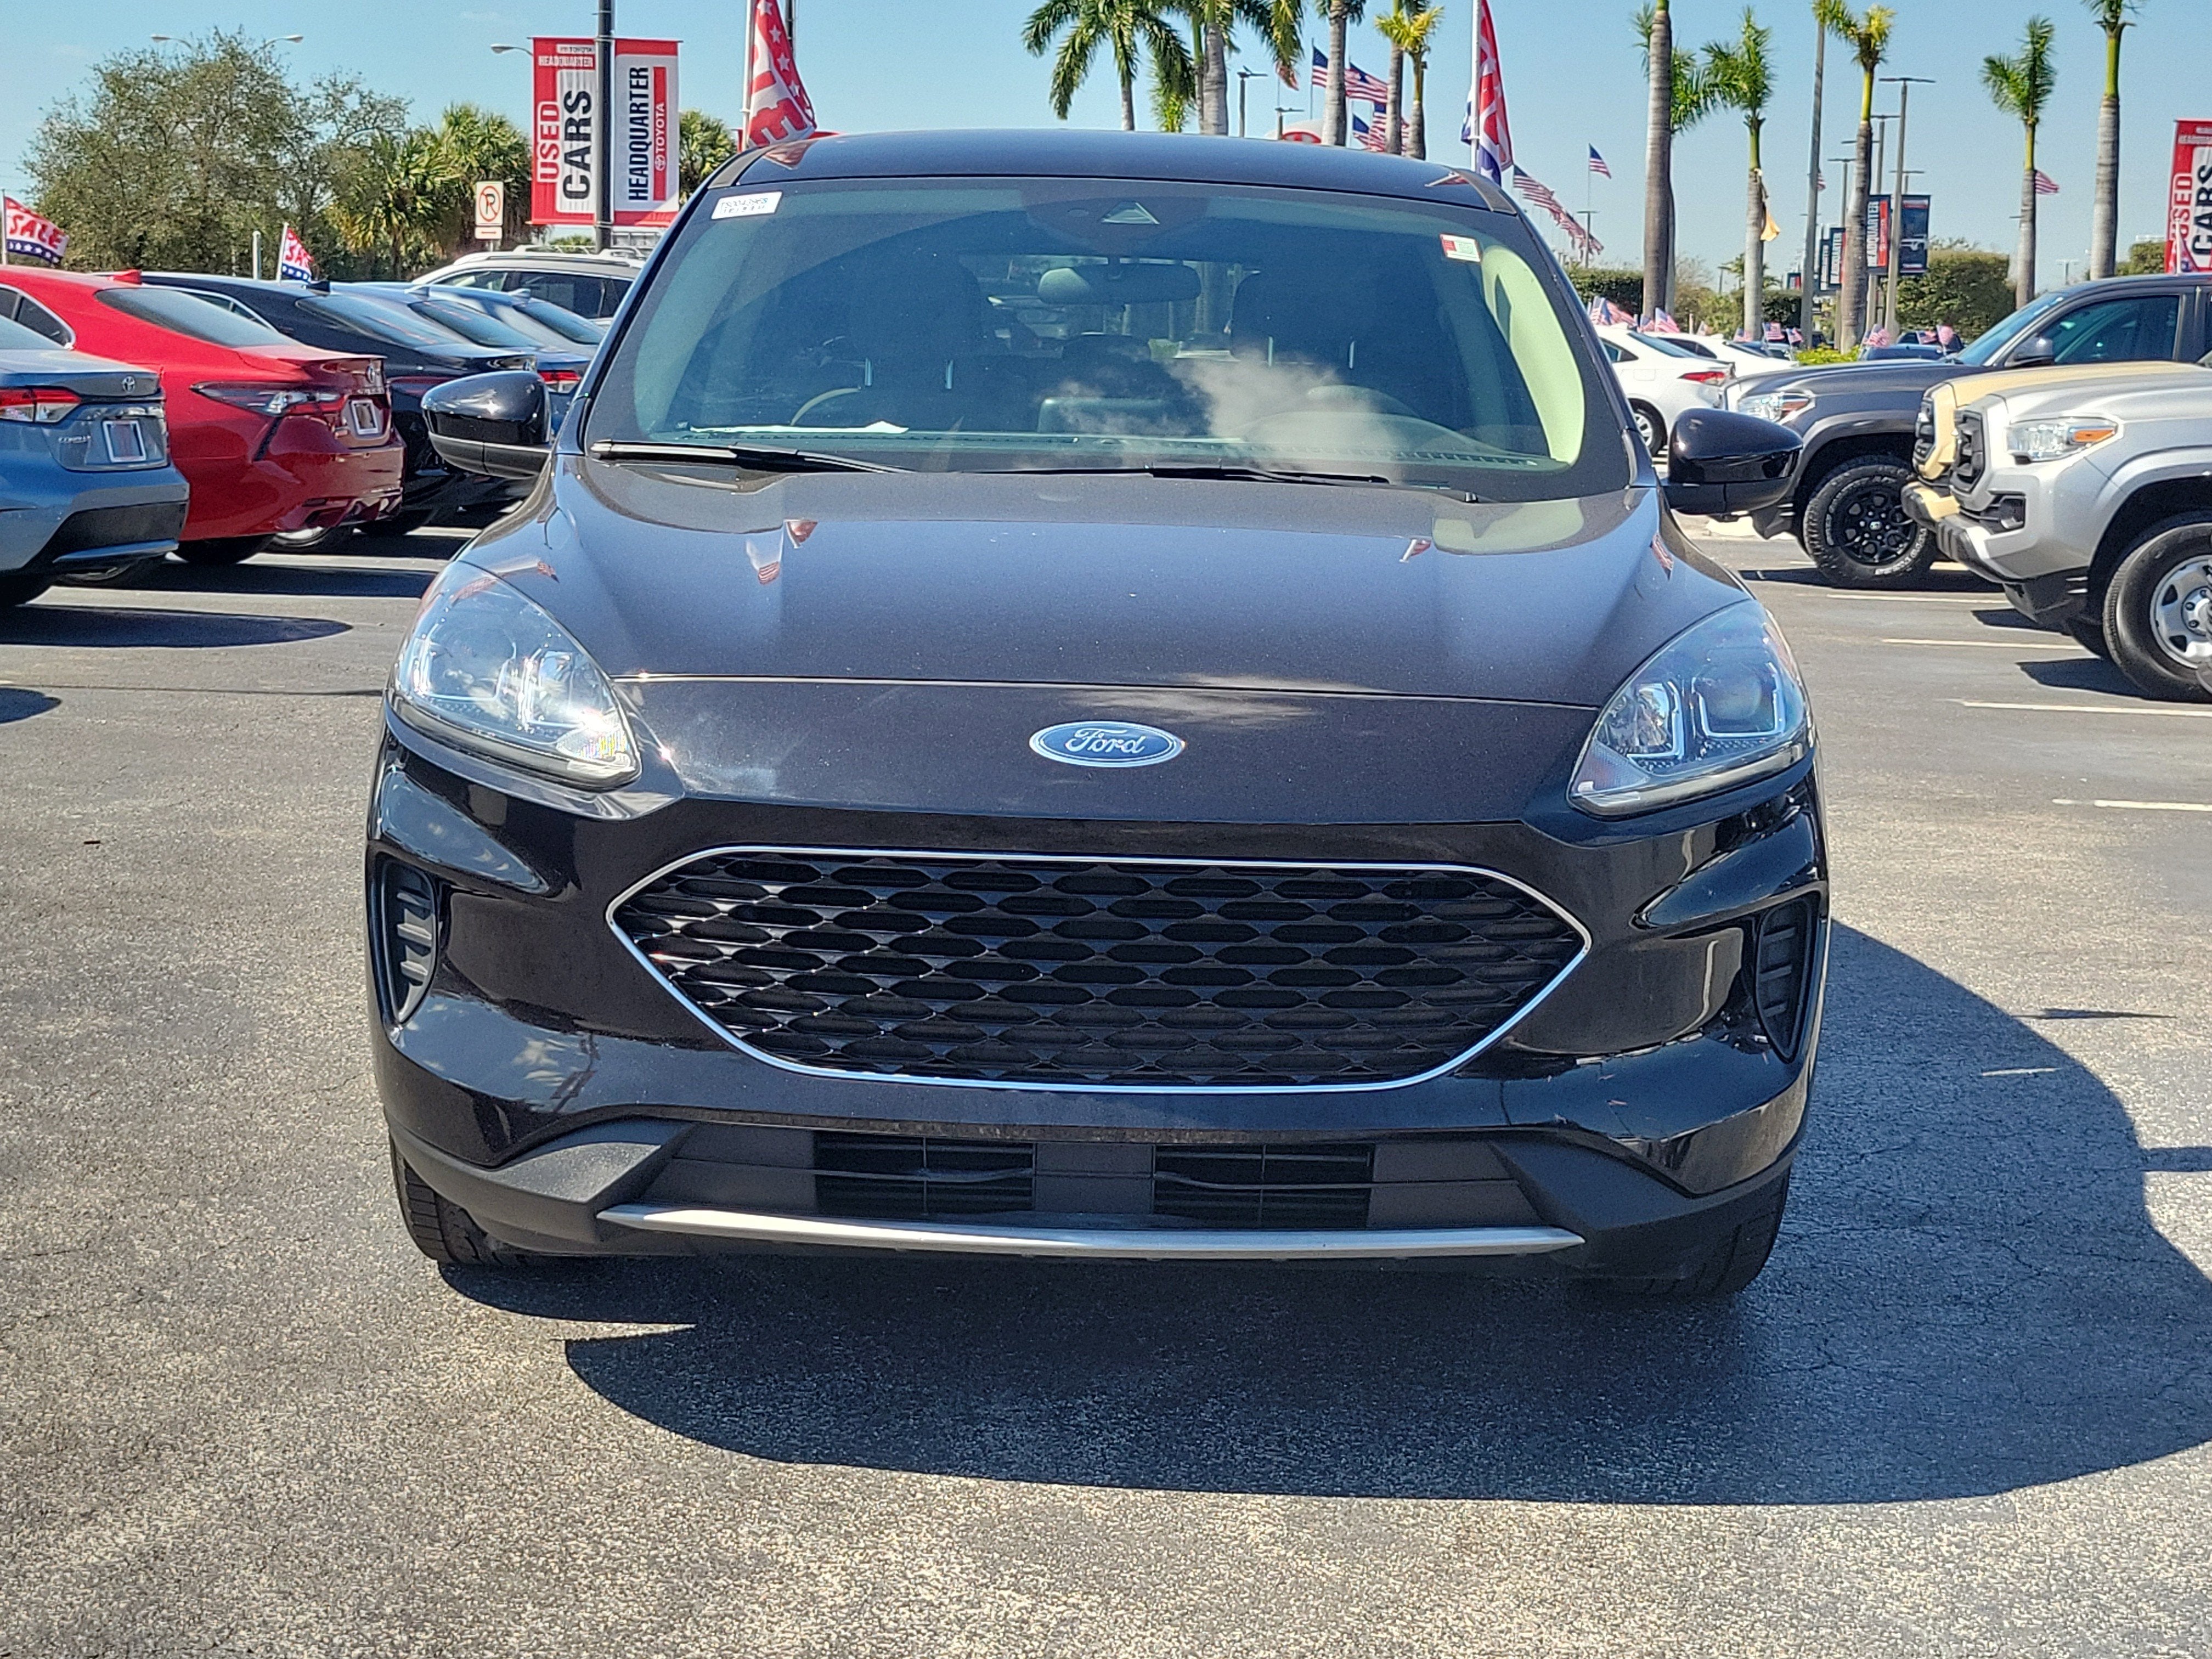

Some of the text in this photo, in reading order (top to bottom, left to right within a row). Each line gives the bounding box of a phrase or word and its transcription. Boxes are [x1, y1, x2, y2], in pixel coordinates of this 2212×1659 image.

[539, 104, 560, 180] USED
[563, 91, 591, 200] CARS
[628, 67, 652, 201] HEADQUARTER
[655, 103, 665, 158] TOYOTA
[9, 215, 63, 249] SALE
[1065, 727, 1147, 754] Ford
